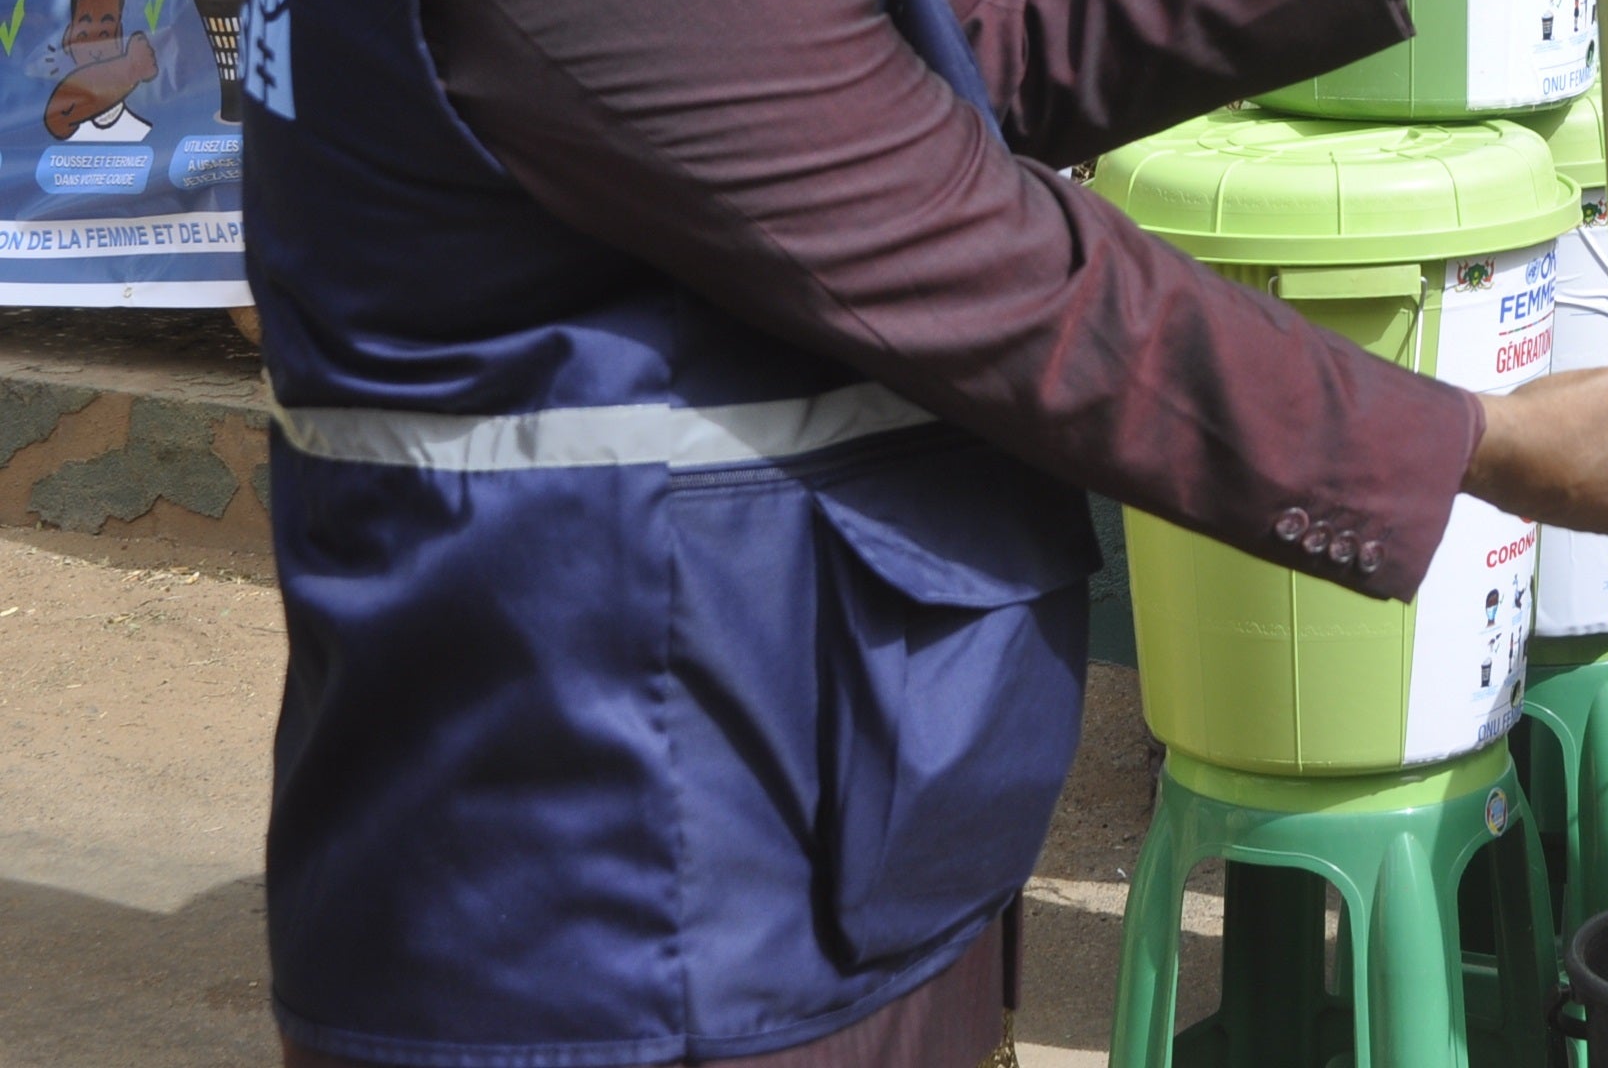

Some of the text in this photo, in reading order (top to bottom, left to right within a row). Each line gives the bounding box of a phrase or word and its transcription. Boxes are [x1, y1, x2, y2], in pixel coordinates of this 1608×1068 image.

[1542, 74, 1566, 96] ONU
[50, 155, 92, 168] TOUSSEZ
[93, 155, 105, 168] ET
[54, 173, 80, 186] DANS
[27, 230, 53, 250] DE
[58, 229, 82, 249] LA
[85, 226, 149, 248] FEMME
[152, 223, 173, 244] ET
[178, 222, 203, 244] DE
[204, 222, 228, 243] LA
